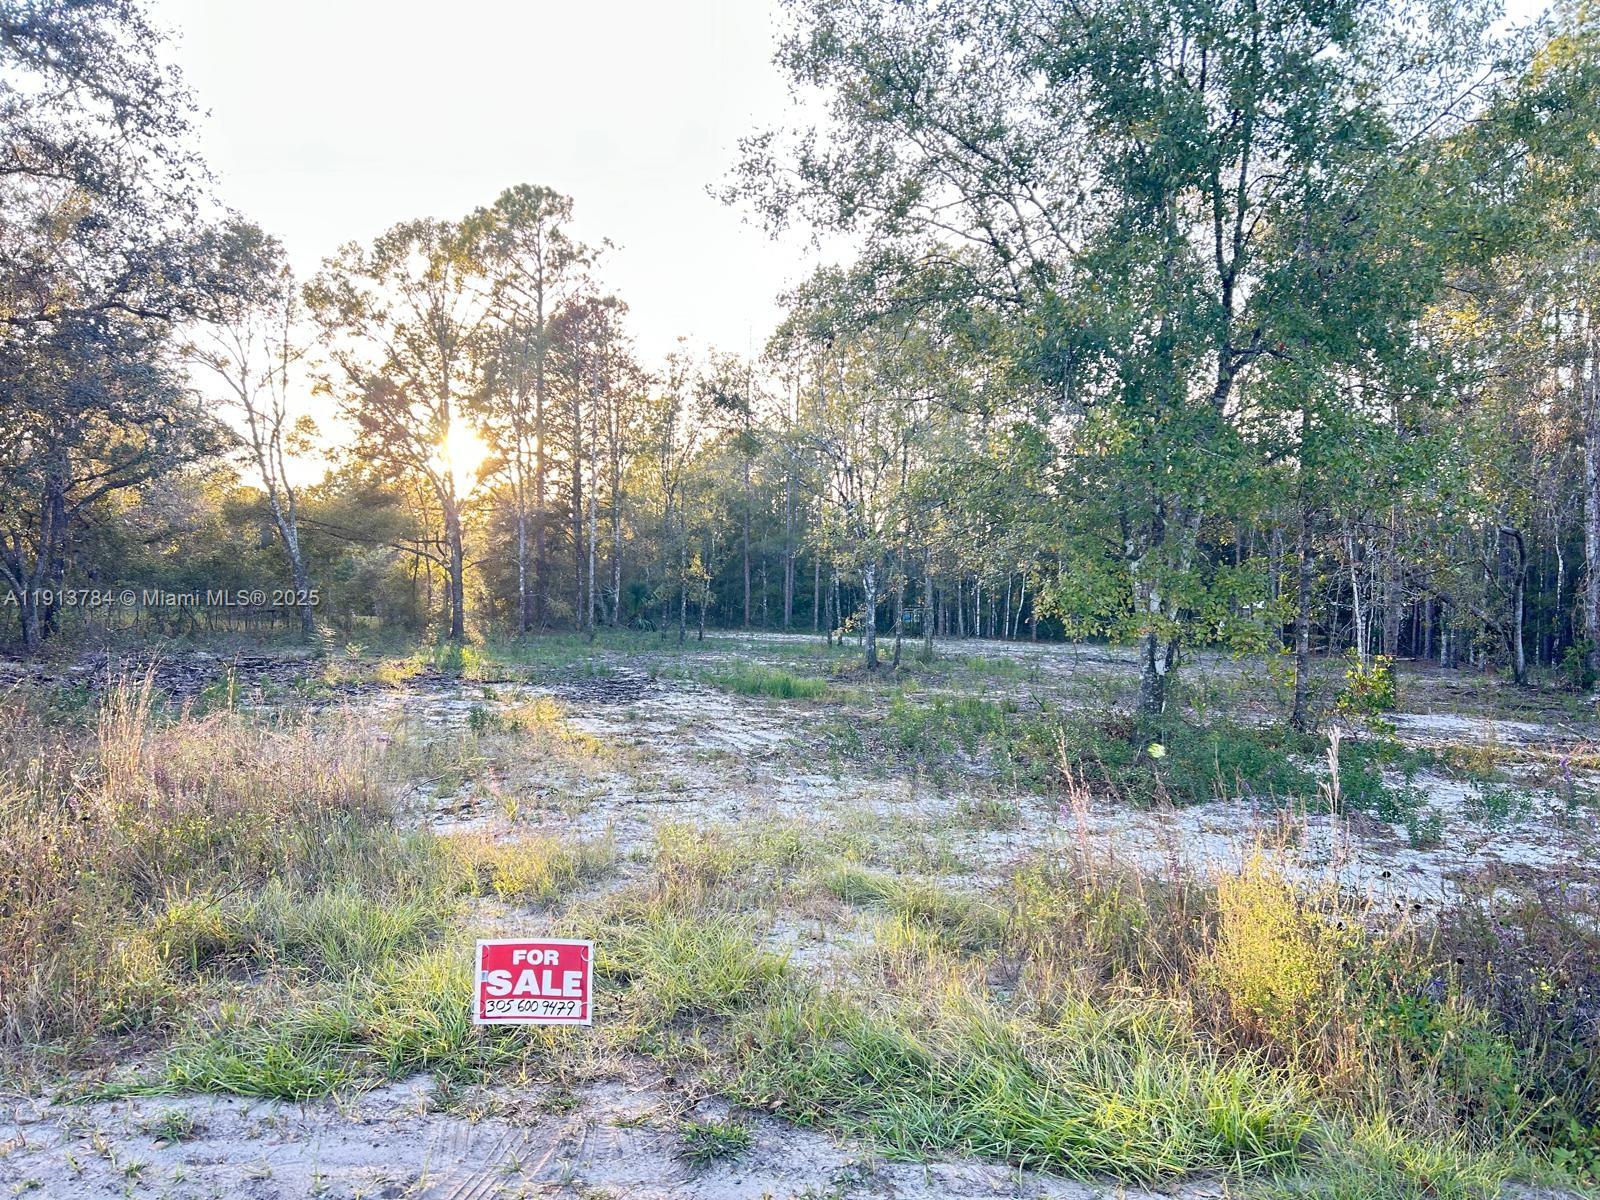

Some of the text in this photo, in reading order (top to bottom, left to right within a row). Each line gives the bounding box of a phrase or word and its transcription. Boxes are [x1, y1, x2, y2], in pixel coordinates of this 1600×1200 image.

[512, 949, 560, 966] FOR
[486, 969, 583, 997] SALE
[486, 999, 576, 1016] 305 600 9479
